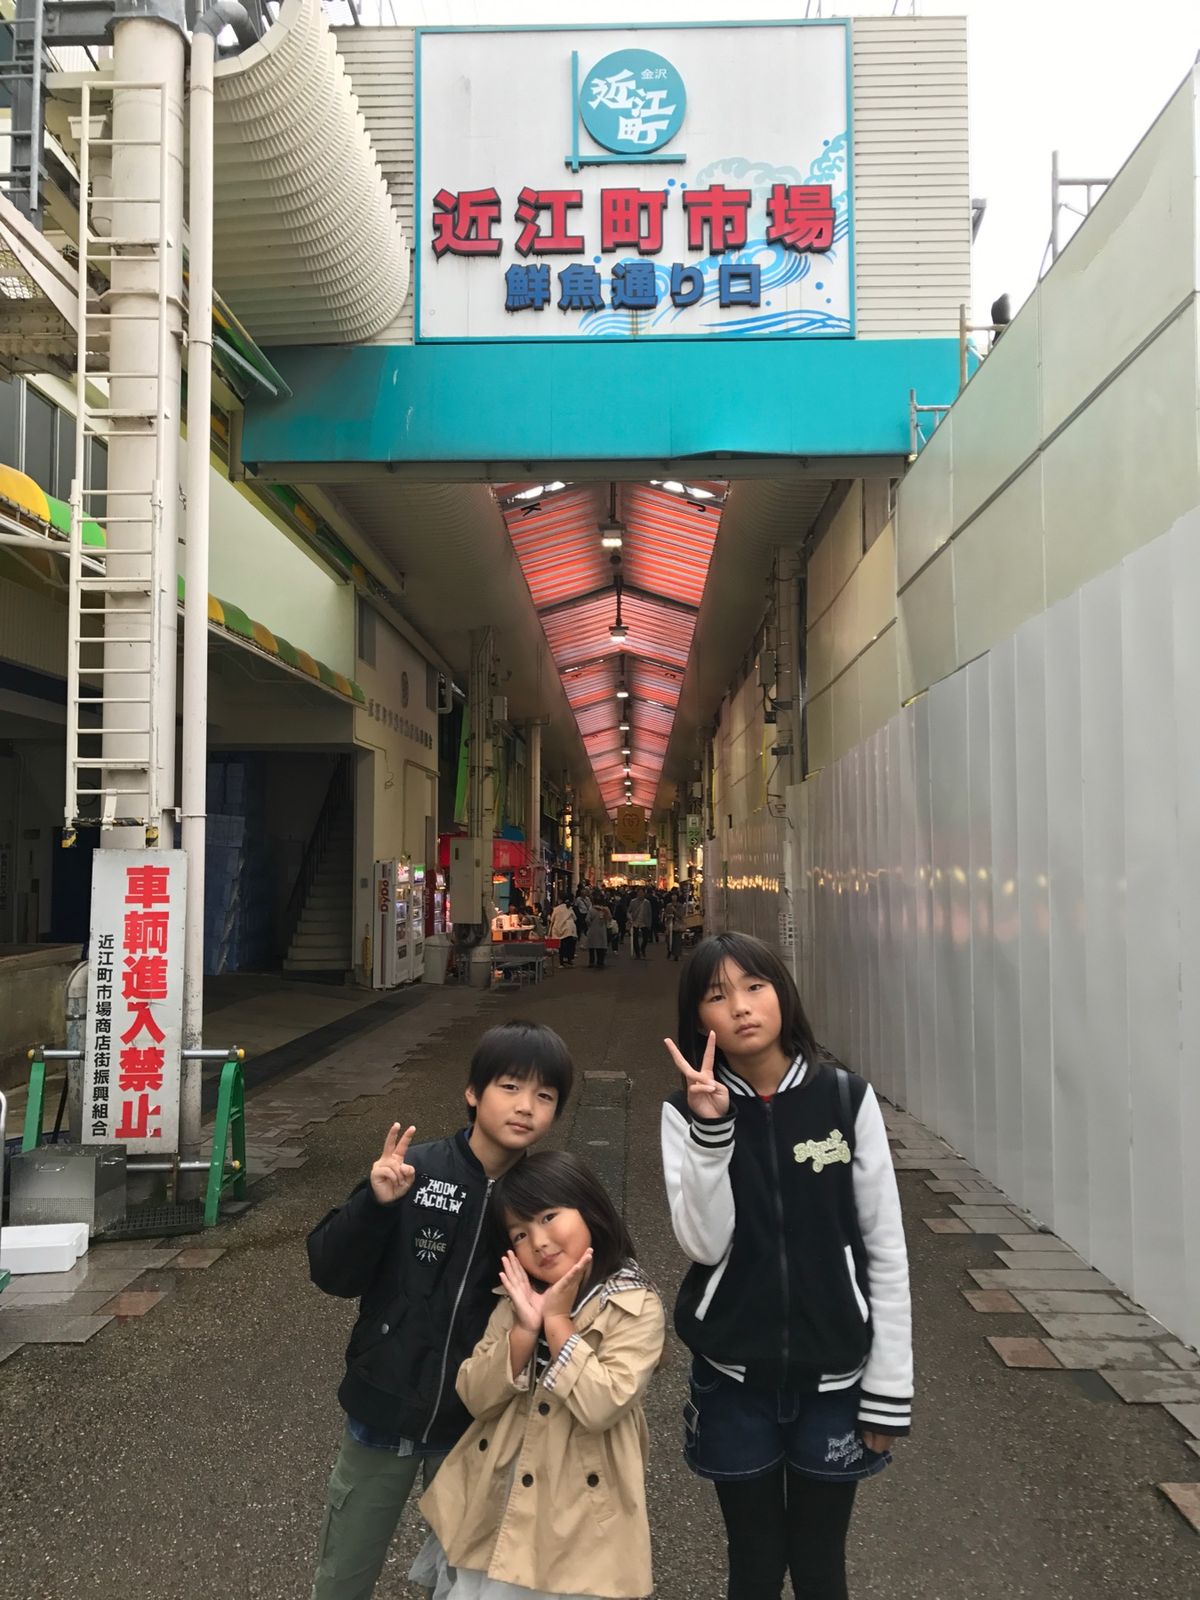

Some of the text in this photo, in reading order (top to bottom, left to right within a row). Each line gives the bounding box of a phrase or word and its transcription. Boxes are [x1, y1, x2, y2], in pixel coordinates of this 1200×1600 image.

[640, 67, 668, 80] 金沢
[587, 68, 677, 145] 近江町
[431, 184, 837, 256] 近江町市場
[504, 261, 762, 312] 鮮魚通り口
[380, 879, 391, 912] DyDo
[91, 934, 114, 1137] 近江町市場商店街振興組合
[414, 1191, 463, 1213] FACULTY
[415, 1238, 447, 1252] VOLTAGE
